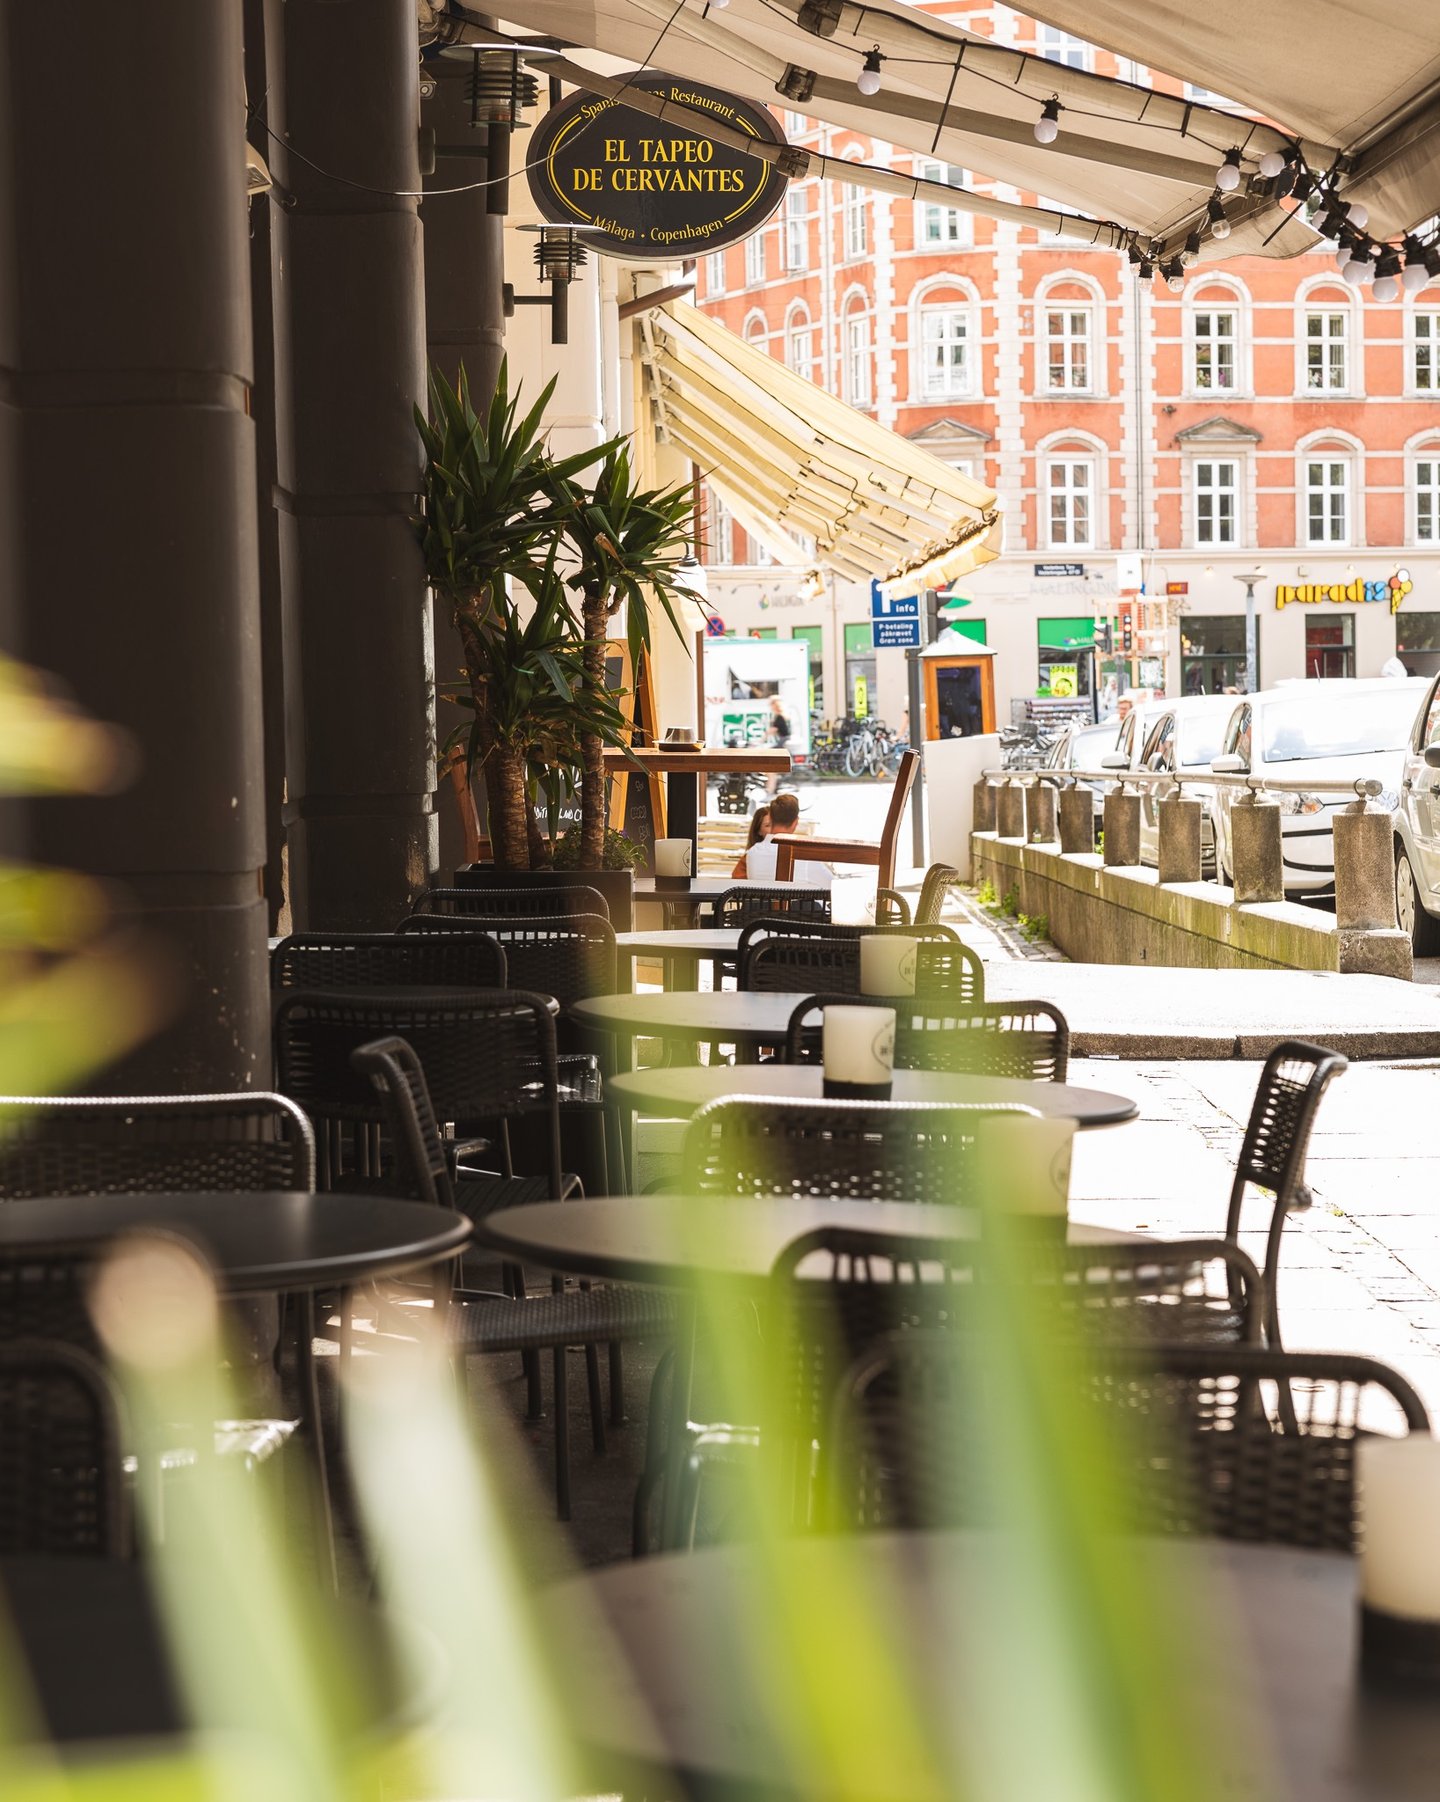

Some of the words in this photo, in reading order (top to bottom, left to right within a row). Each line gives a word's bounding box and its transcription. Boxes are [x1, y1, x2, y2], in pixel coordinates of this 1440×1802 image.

[580, 97, 622, 119] Spanis
[671, 87, 735, 120] Restaurant
[604, 139, 631, 162] EL
[638, 139, 714, 163] TAPEO
[573, 168, 604, 191] DE
[611, 168, 745, 192] CERVANTES
[592, 215, 636, 241] Málaga
[650, 219, 724, 245] Copenhagen
[1275, 577, 1387, 610] paradis
